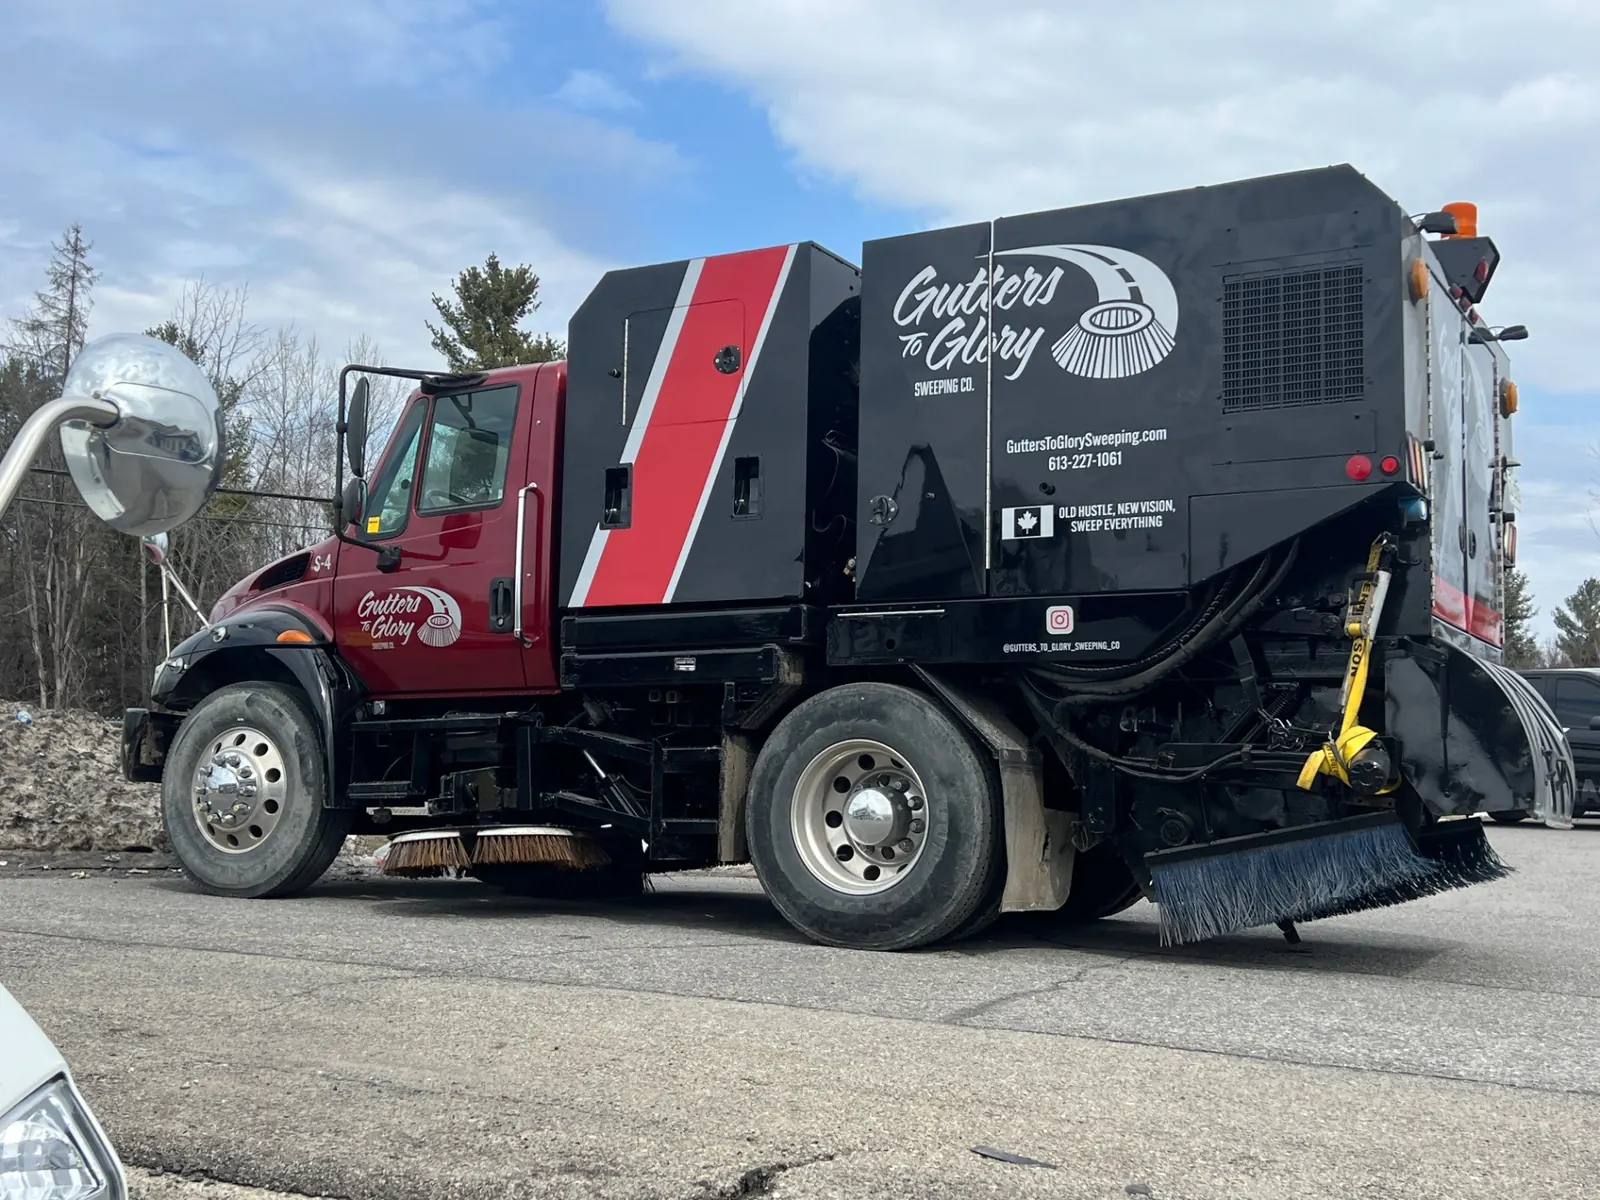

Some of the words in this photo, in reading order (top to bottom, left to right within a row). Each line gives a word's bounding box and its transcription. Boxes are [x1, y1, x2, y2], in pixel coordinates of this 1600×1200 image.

[893, 265, 1064, 326] Gutters
[925, 316, 1045, 381] Glory
[914, 379, 958, 397] SWEEPING
[960, 377, 975, 393] CO.
[1006, 428, 1167, 453] GuttersToGlorySweeping.com
[1048, 451, 1122, 471] 613-227-1061
[1058, 506, 1077, 519] OLD
[1078, 504, 1116, 517] HUSTLE,
[1117, 502, 1140, 515] NEW
[1140, 499, 1176, 513] VISION,
[1070, 519, 1102, 532] SWEEP
[1104, 515, 1163, 531] EVERYTHING
[313, 553, 331, 572] S-4
[357, 590, 422, 618] Gutters
[371, 615, 415, 646] Glory
[1003, 640, 1121, 653] @GUTTERS_TO_GLORY_SWEEPING_CO
